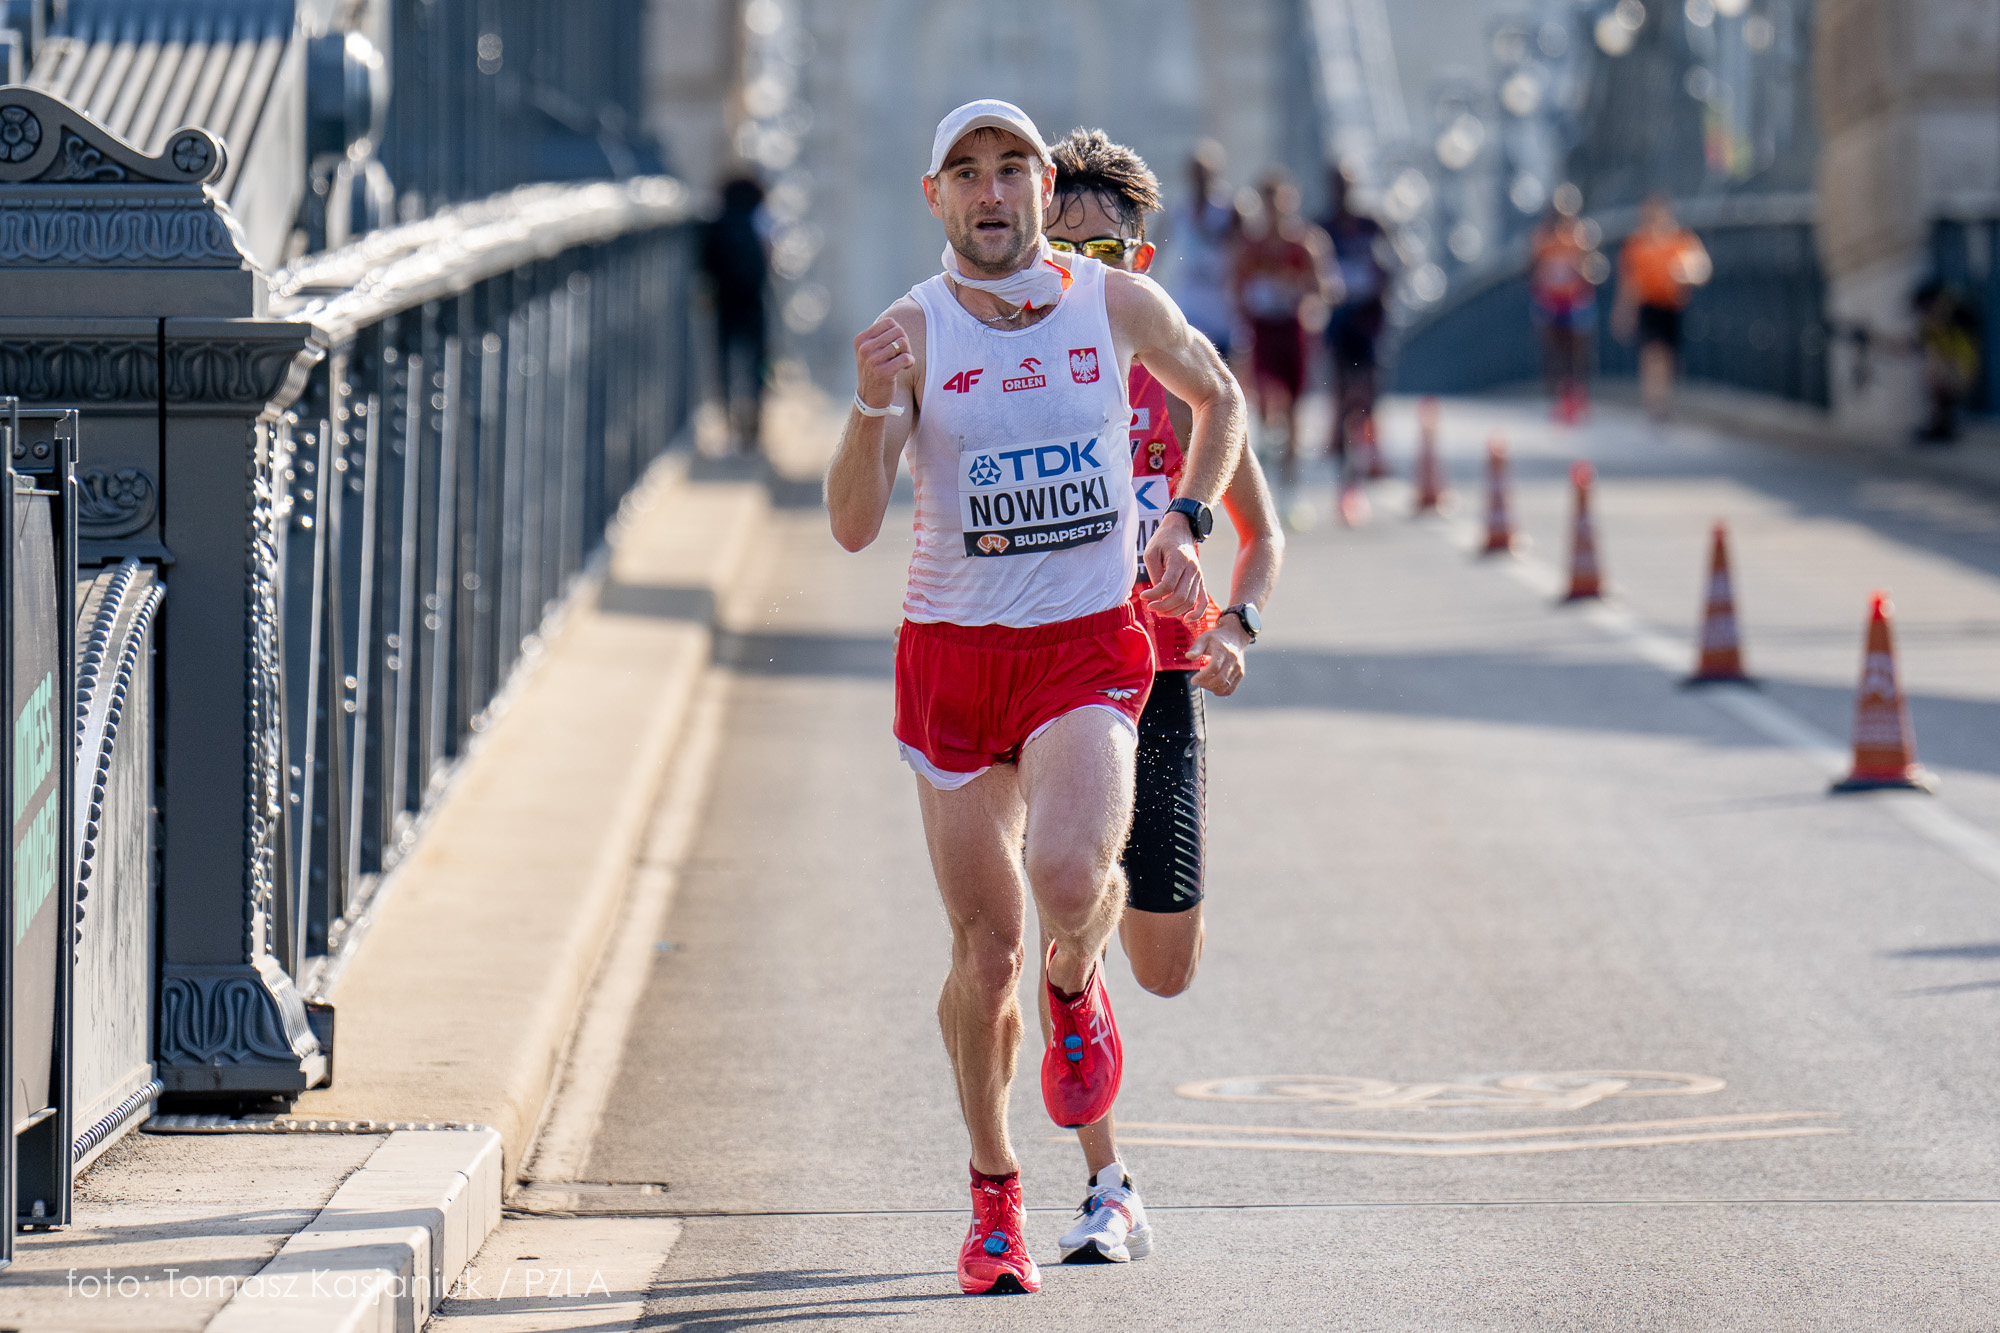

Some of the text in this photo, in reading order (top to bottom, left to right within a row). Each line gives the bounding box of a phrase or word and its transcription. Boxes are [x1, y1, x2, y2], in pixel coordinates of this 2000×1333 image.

[943, 368, 984, 394] 4F
[1004, 376, 1044, 391] ORLEN
[998, 437, 1102, 481] TDK
[968, 475, 1110, 527] NOWICKI
[1014, 520, 1113, 547] BUDAPEST 23
[16, 788, 57, 946] WONDER
